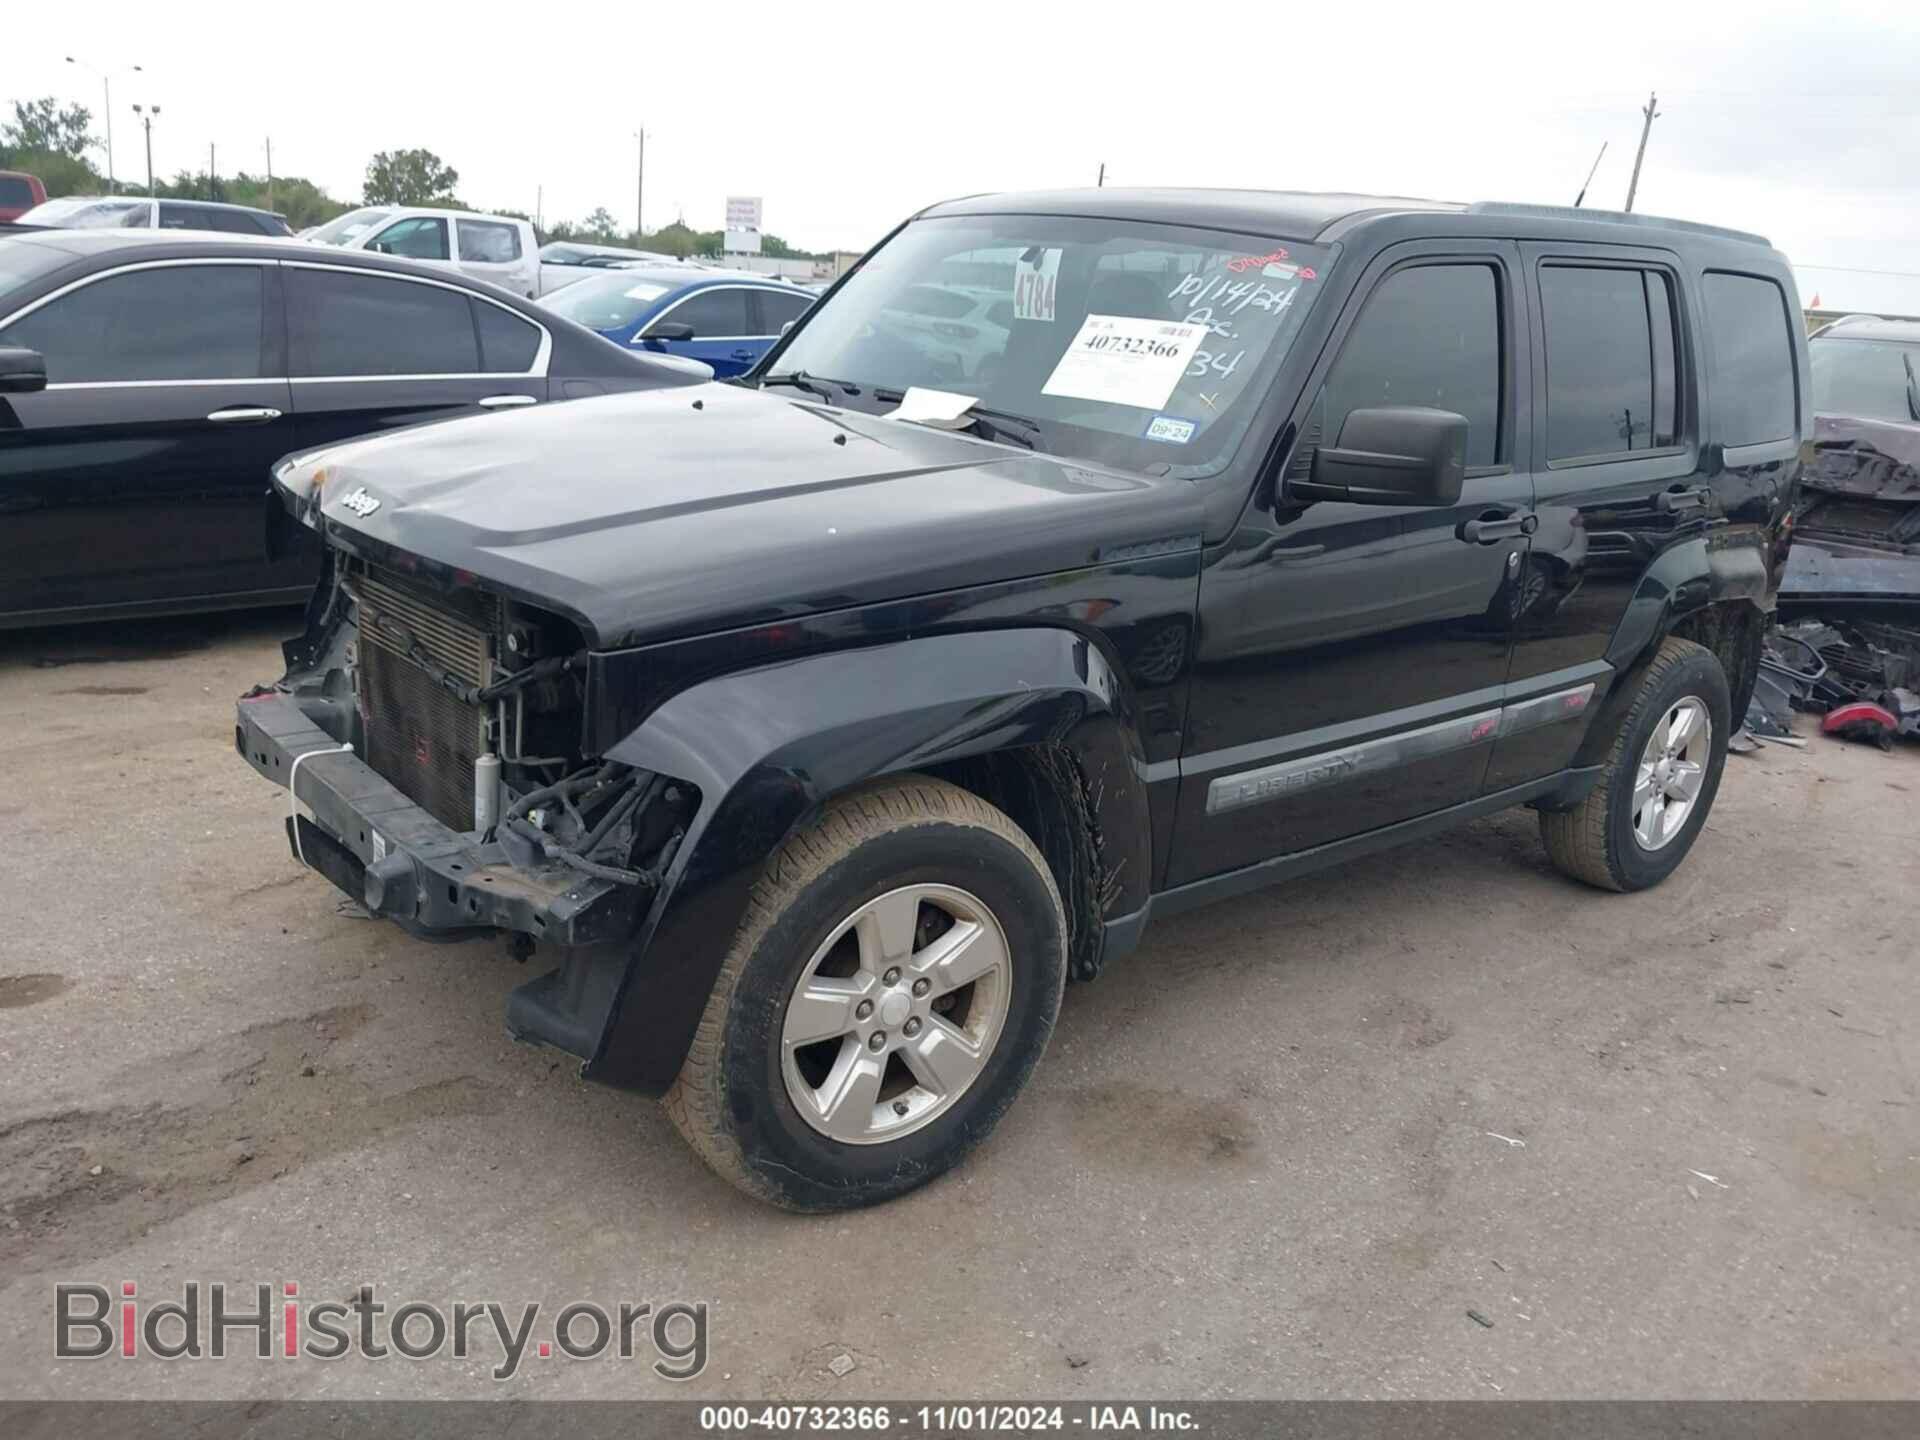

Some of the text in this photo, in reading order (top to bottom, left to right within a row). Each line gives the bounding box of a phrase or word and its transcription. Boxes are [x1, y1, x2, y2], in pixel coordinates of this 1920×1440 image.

[1015, 272, 1056, 319] 4784
[1084, 335, 1179, 358] 40732366
[341, 487, 381, 517] Jeep
